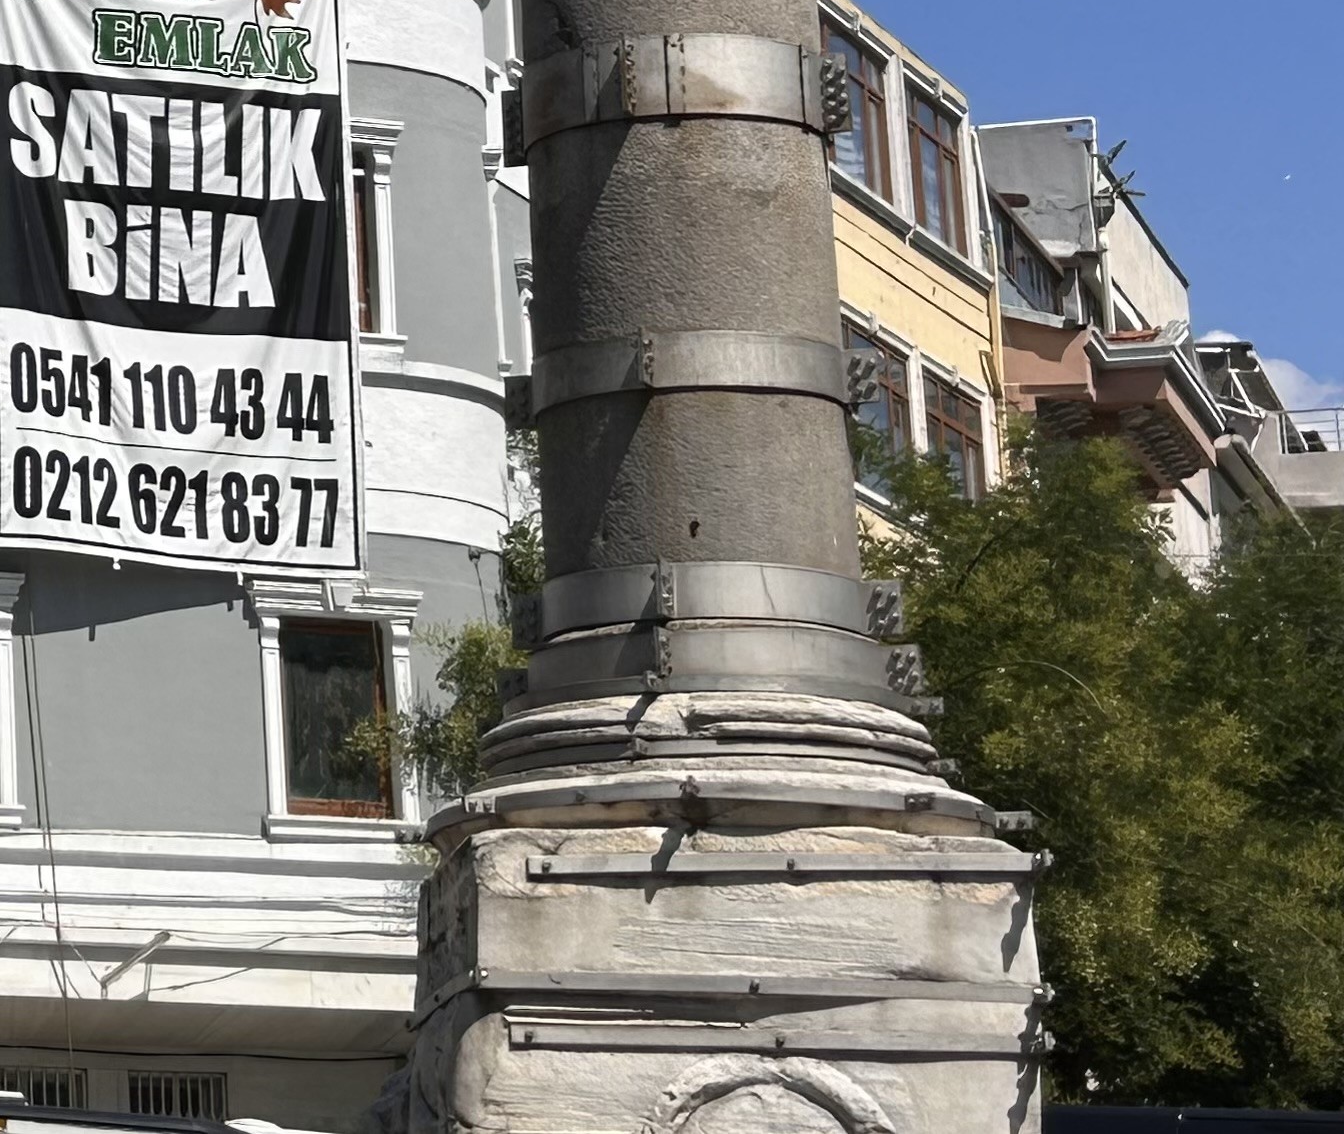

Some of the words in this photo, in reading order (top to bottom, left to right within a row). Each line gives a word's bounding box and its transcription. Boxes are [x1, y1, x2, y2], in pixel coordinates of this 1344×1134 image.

[93, 9, 317, 81] EMLAK
[8, 81, 326, 201] SATILIK
[10, 342, 111, 426] 0541
[123, 362, 197, 434] 110
[210, 368, 265, 440] 43
[277, 373, 334, 443] 44
[13, 446, 120, 528] 0212
[128, 463, 209, 539] 621
[221, 472, 280, 546] 83
[291, 477, 338, 547] 77
